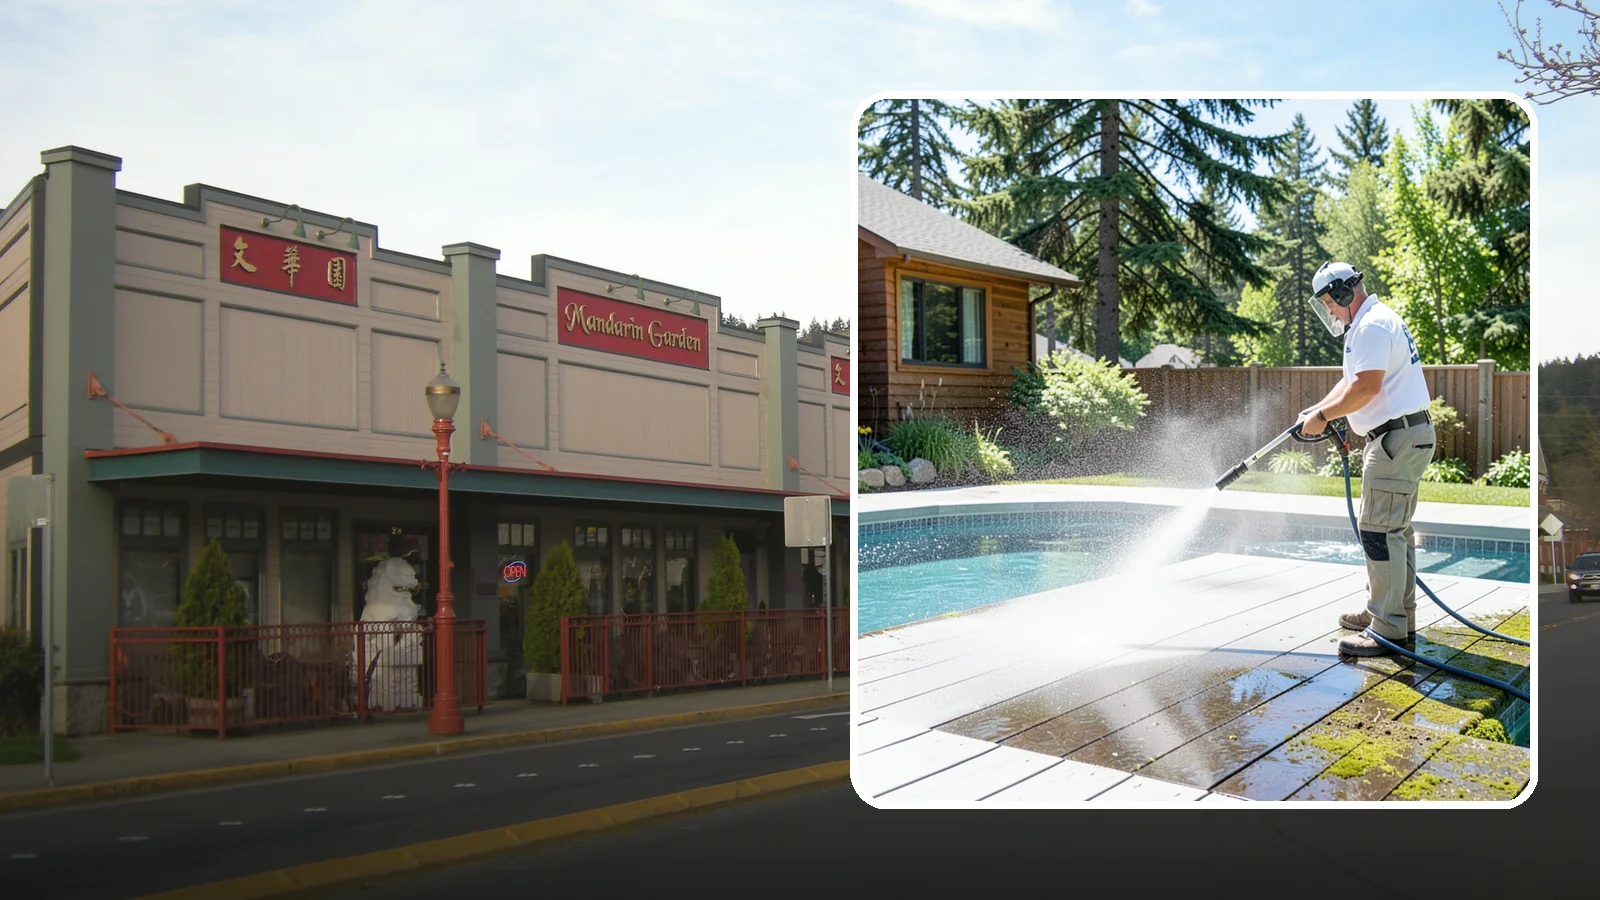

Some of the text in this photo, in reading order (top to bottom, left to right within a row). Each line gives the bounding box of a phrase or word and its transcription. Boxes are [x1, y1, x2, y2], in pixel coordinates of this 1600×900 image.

[231, 235, 346, 291] 文華園
[564, 302, 701, 352] Mandarin Garden
[503, 565, 527, 578] OPEN
